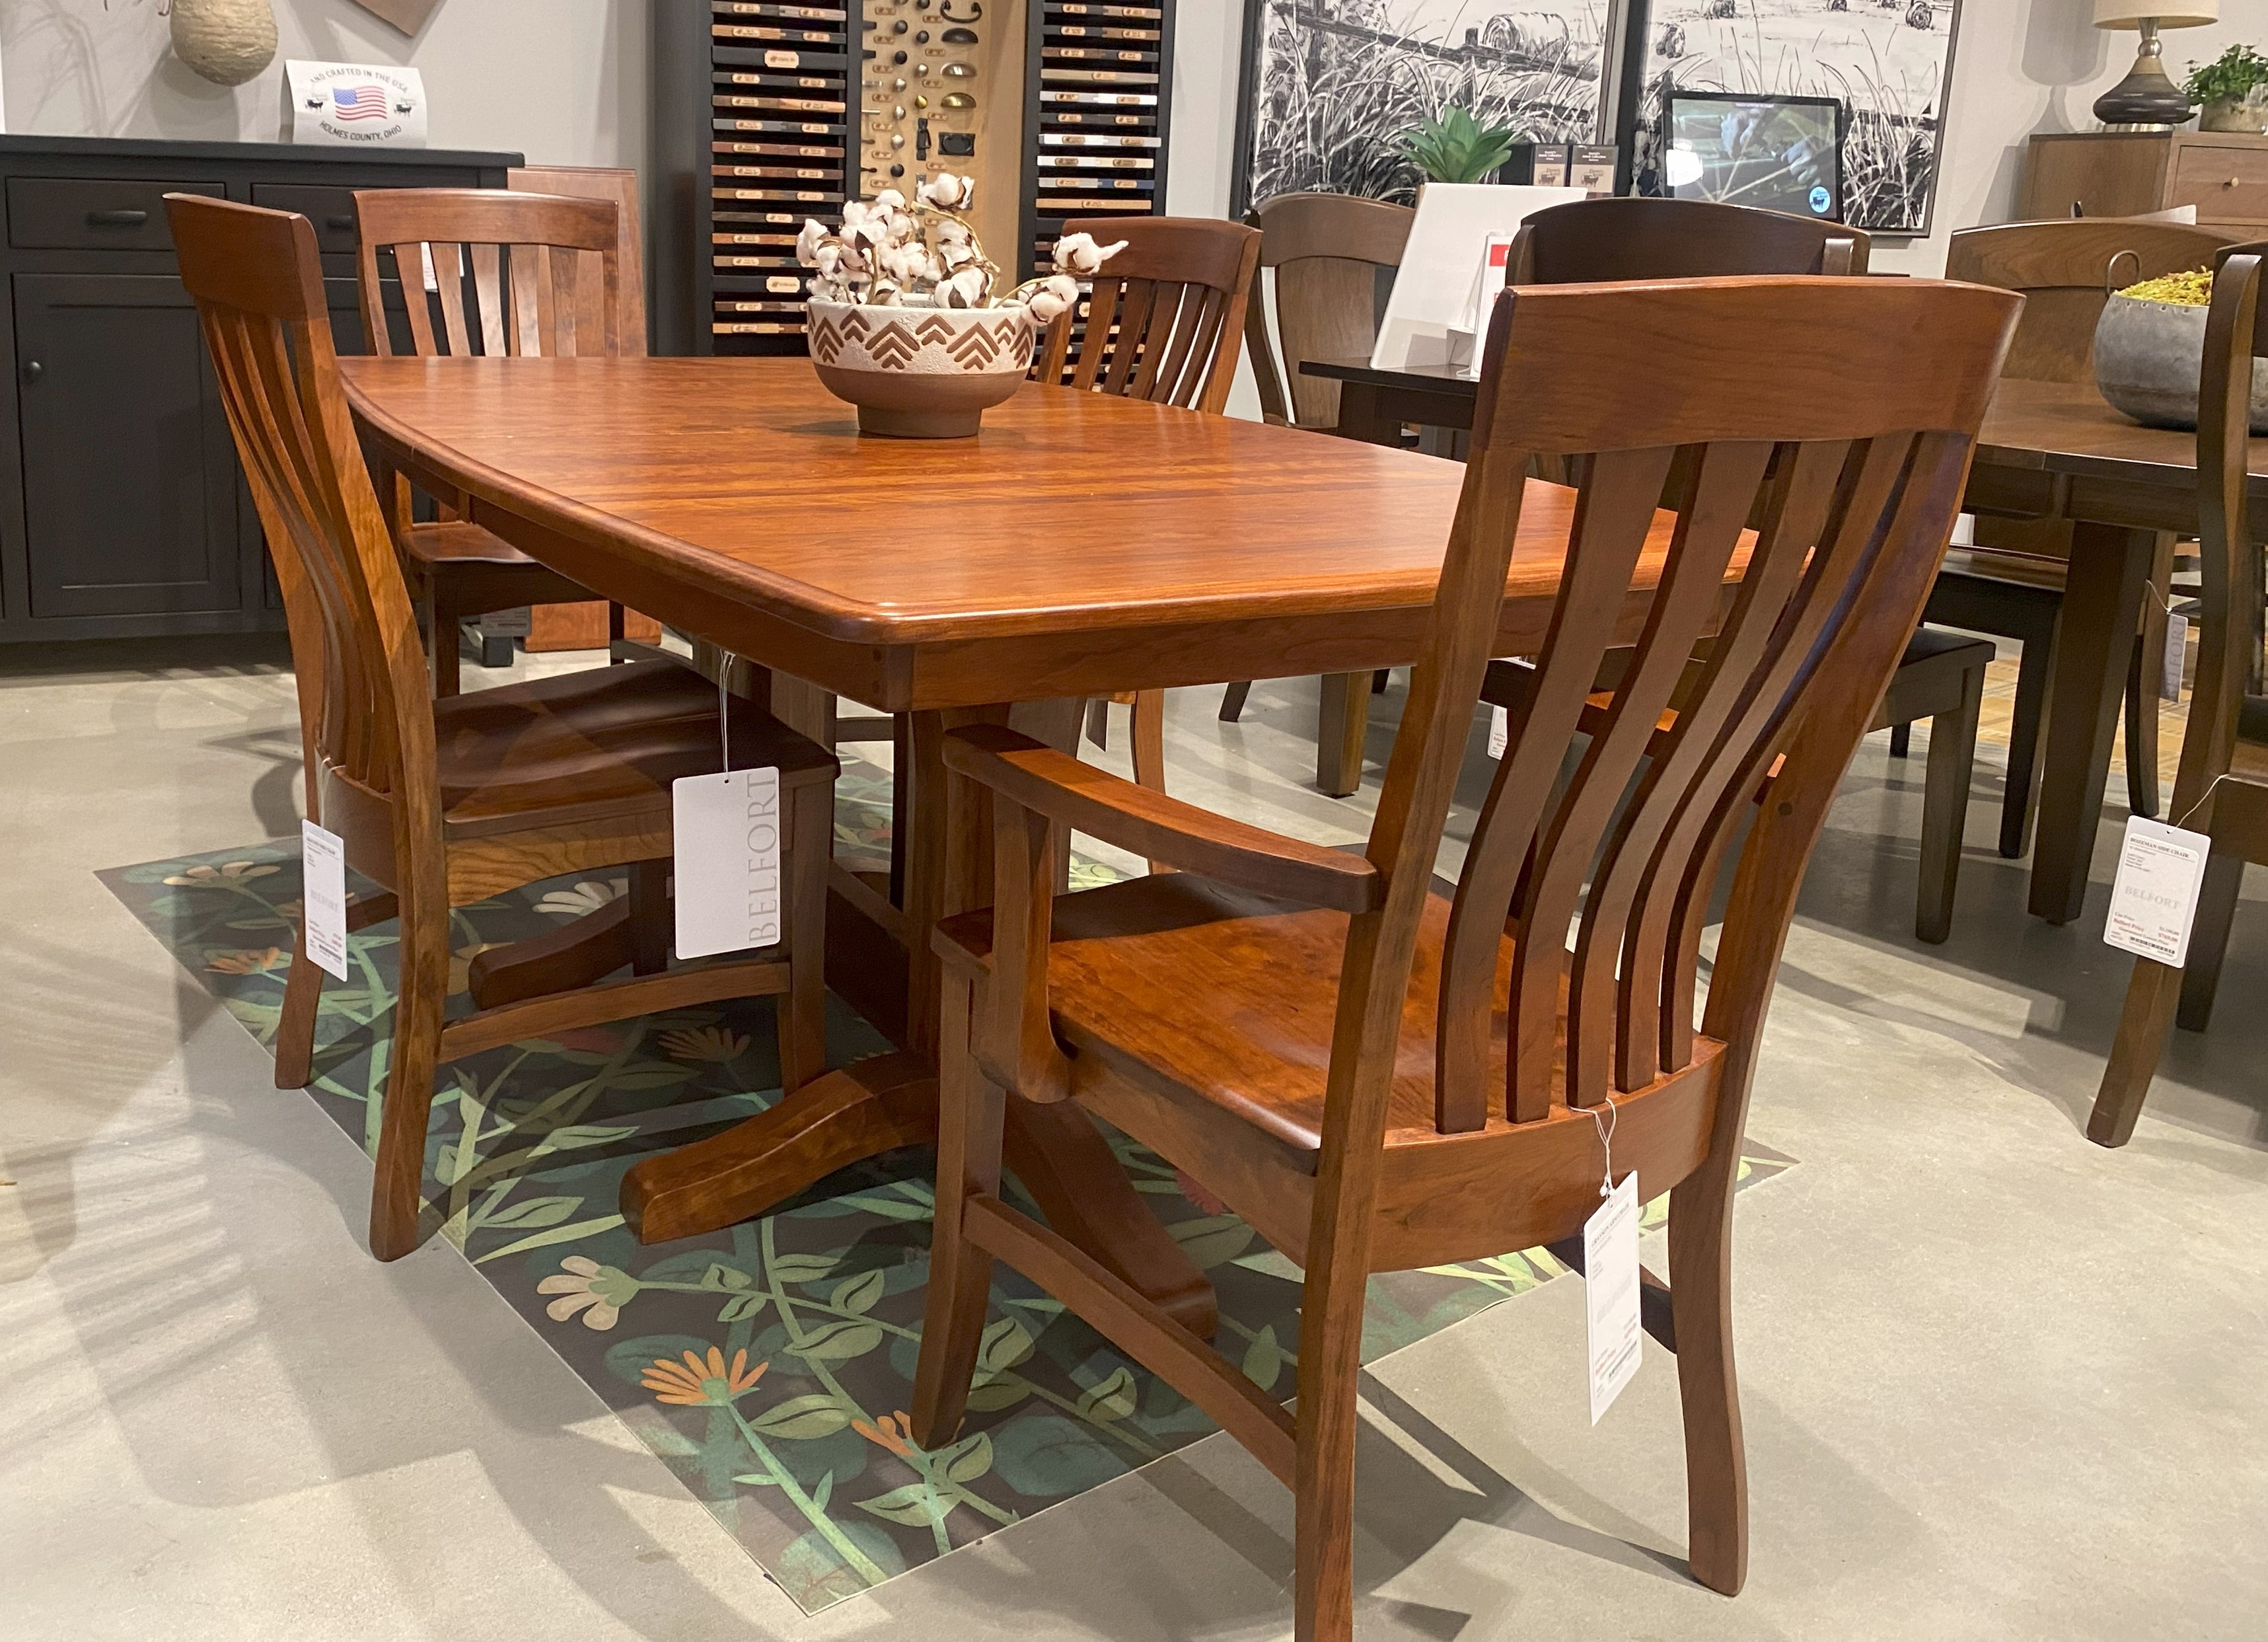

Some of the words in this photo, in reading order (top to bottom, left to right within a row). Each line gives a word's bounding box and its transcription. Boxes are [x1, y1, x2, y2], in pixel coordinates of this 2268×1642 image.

[326, 69, 361, 77] CRAFTED
[375, 72, 390, 83] THE
[392, 79, 408, 93] USA
[320, 121, 349, 139] HOLMES
[384, 125, 402, 138] OHIO
[747, 772, 778, 944] BELFORT
[2171, 849, 2189, 858] CHAIR
[2125, 885, 2180, 909] BELFORT
